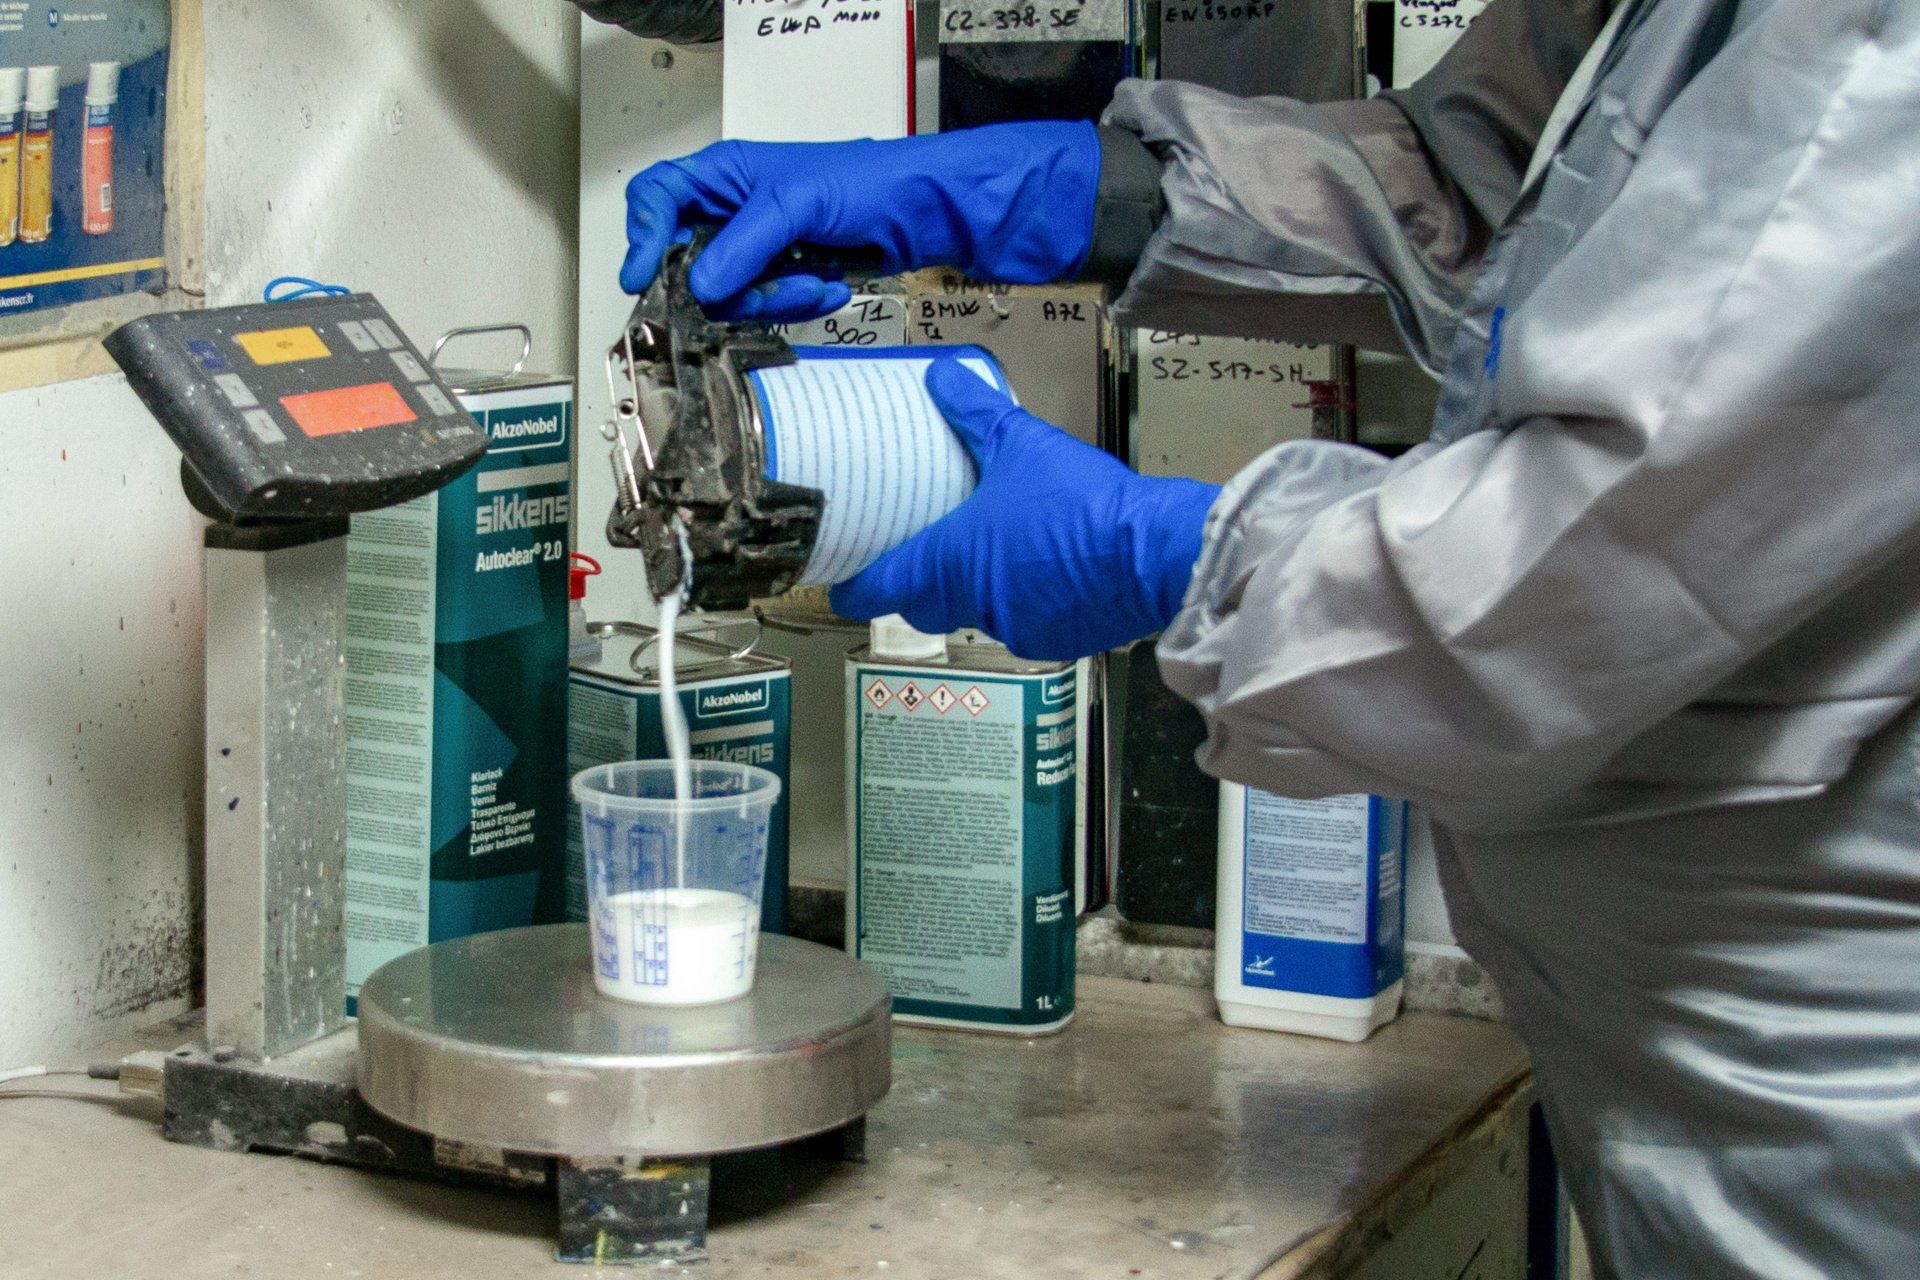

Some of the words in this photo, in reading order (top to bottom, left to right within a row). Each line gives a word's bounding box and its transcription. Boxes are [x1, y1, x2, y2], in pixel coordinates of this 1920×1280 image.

[852, 300, 893, 323] T1
[922, 301, 980, 318] BMW
[492, 416, 558, 439] AkzoNobel
[476, 493, 568, 535] sikkens
[543, 540, 562, 562] 2.0
[703, 688, 762, 708] AkzoNobel
[1036, 995, 1053, 1010] 1L
